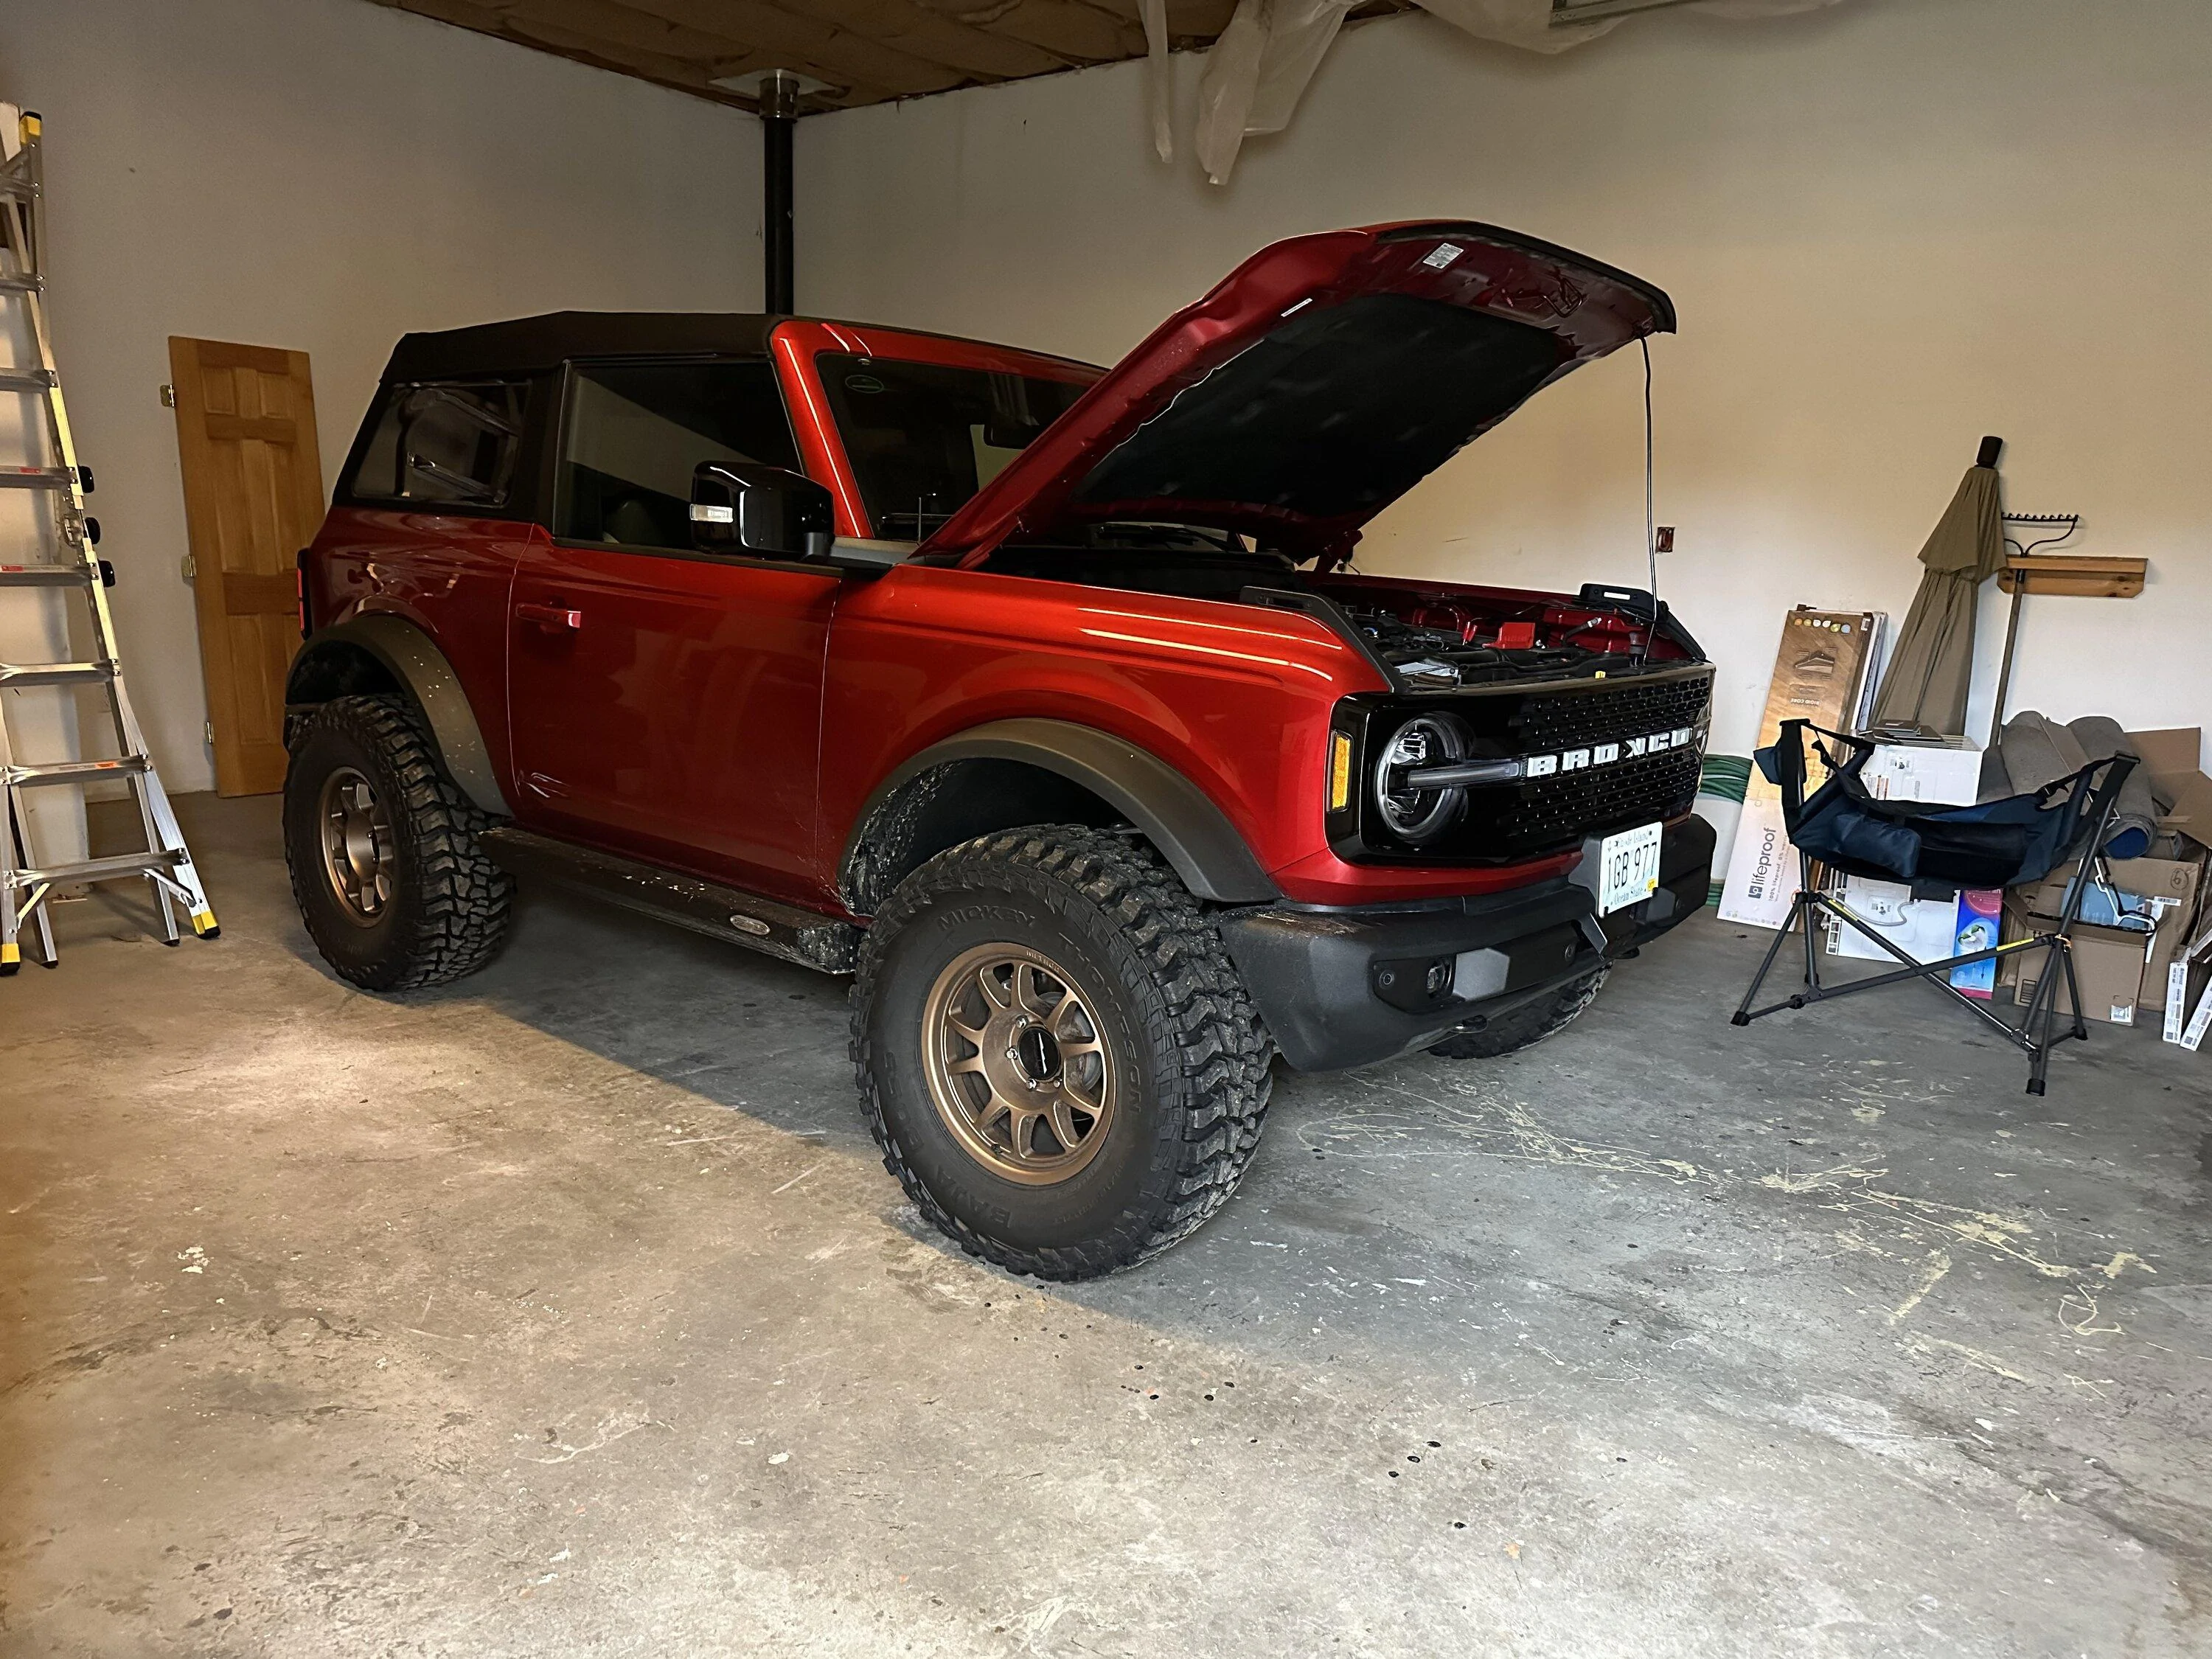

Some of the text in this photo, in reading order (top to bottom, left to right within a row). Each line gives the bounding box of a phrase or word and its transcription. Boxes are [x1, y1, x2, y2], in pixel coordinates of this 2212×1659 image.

[1527, 727, 1692, 777] BRONCO
[1607, 841, 1657, 894] 1GB 977
[1751, 827, 1776, 885] lifeproof
[938, 905, 1142, 1113] MICKEY THOMPSON
